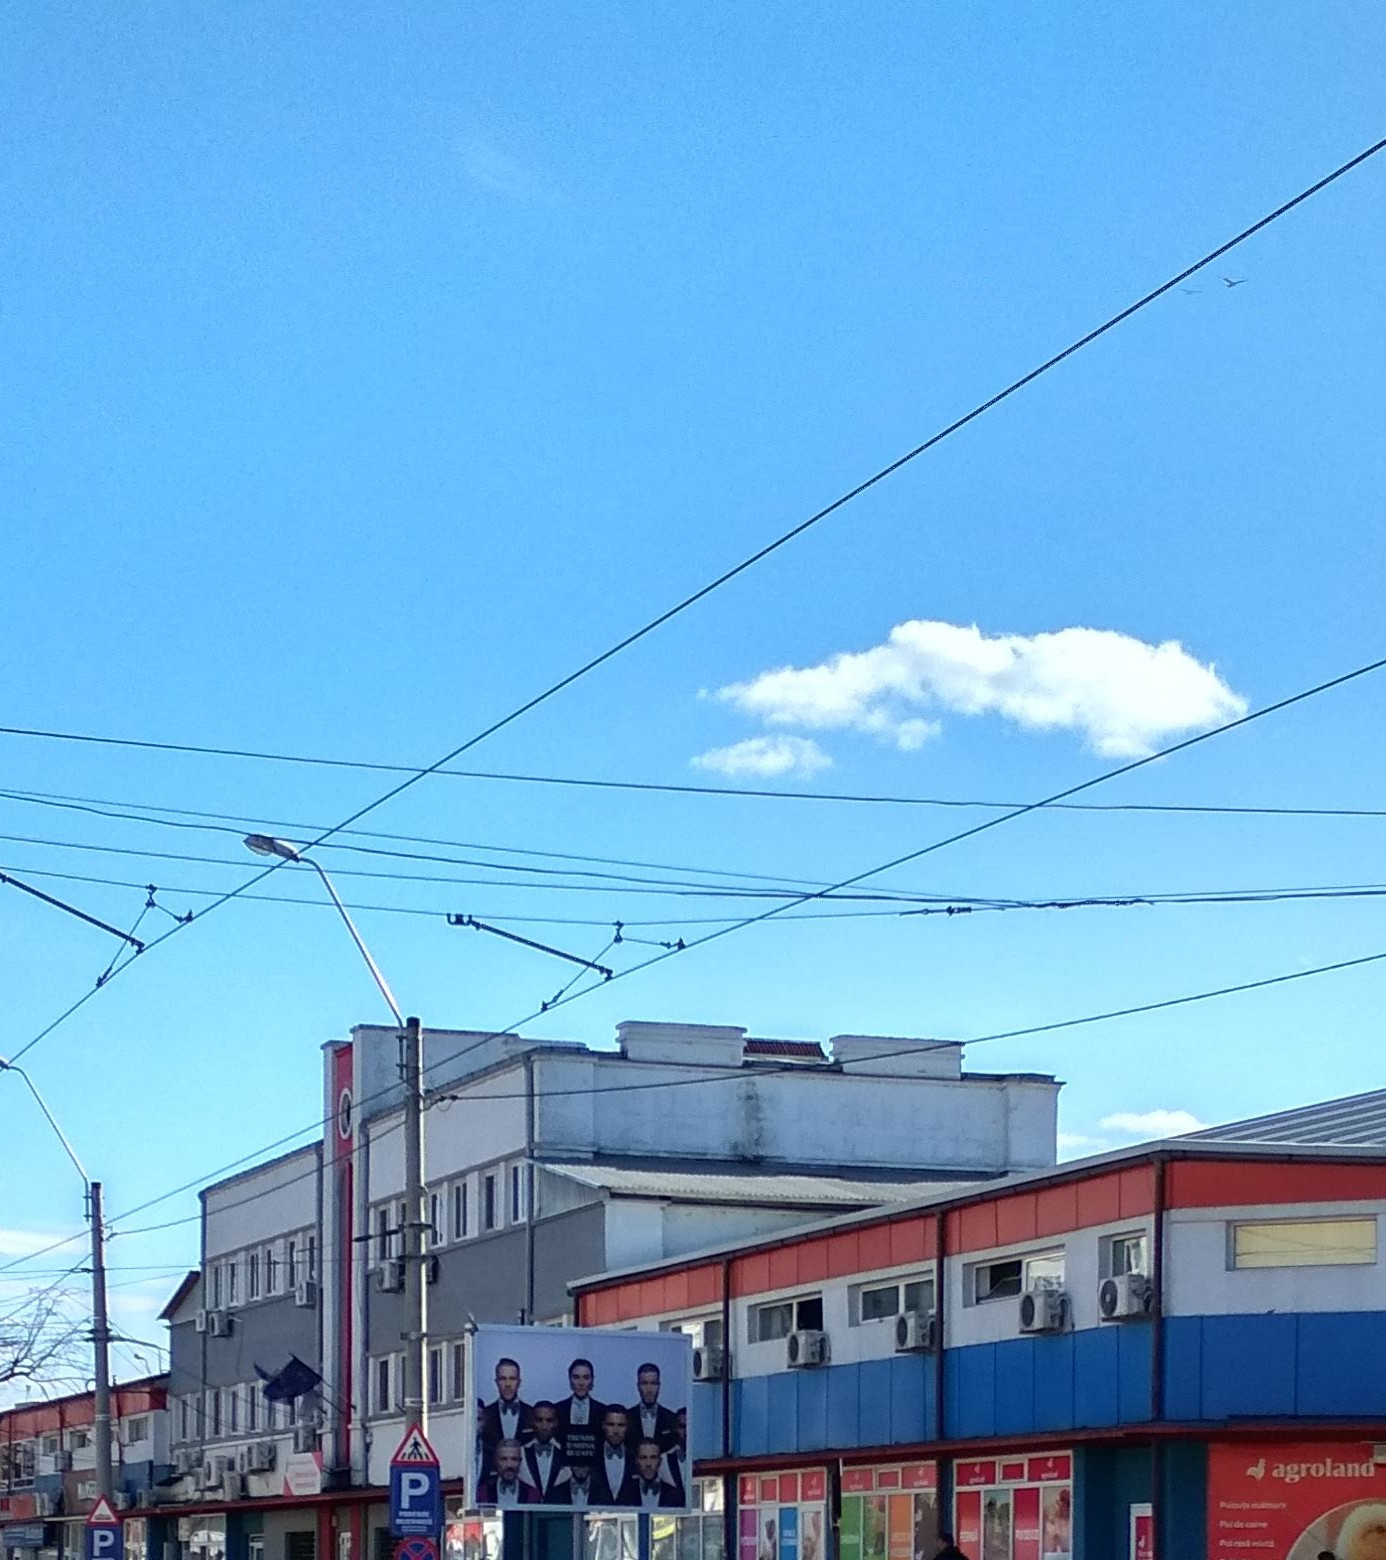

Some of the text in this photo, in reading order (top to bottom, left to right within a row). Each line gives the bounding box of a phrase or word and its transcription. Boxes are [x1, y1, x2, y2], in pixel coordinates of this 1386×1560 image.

[1271, 1458, 1375, 1483] agroland
[401, 1472, 430, 1509] P
[93, 1530, 114, 1556] P
